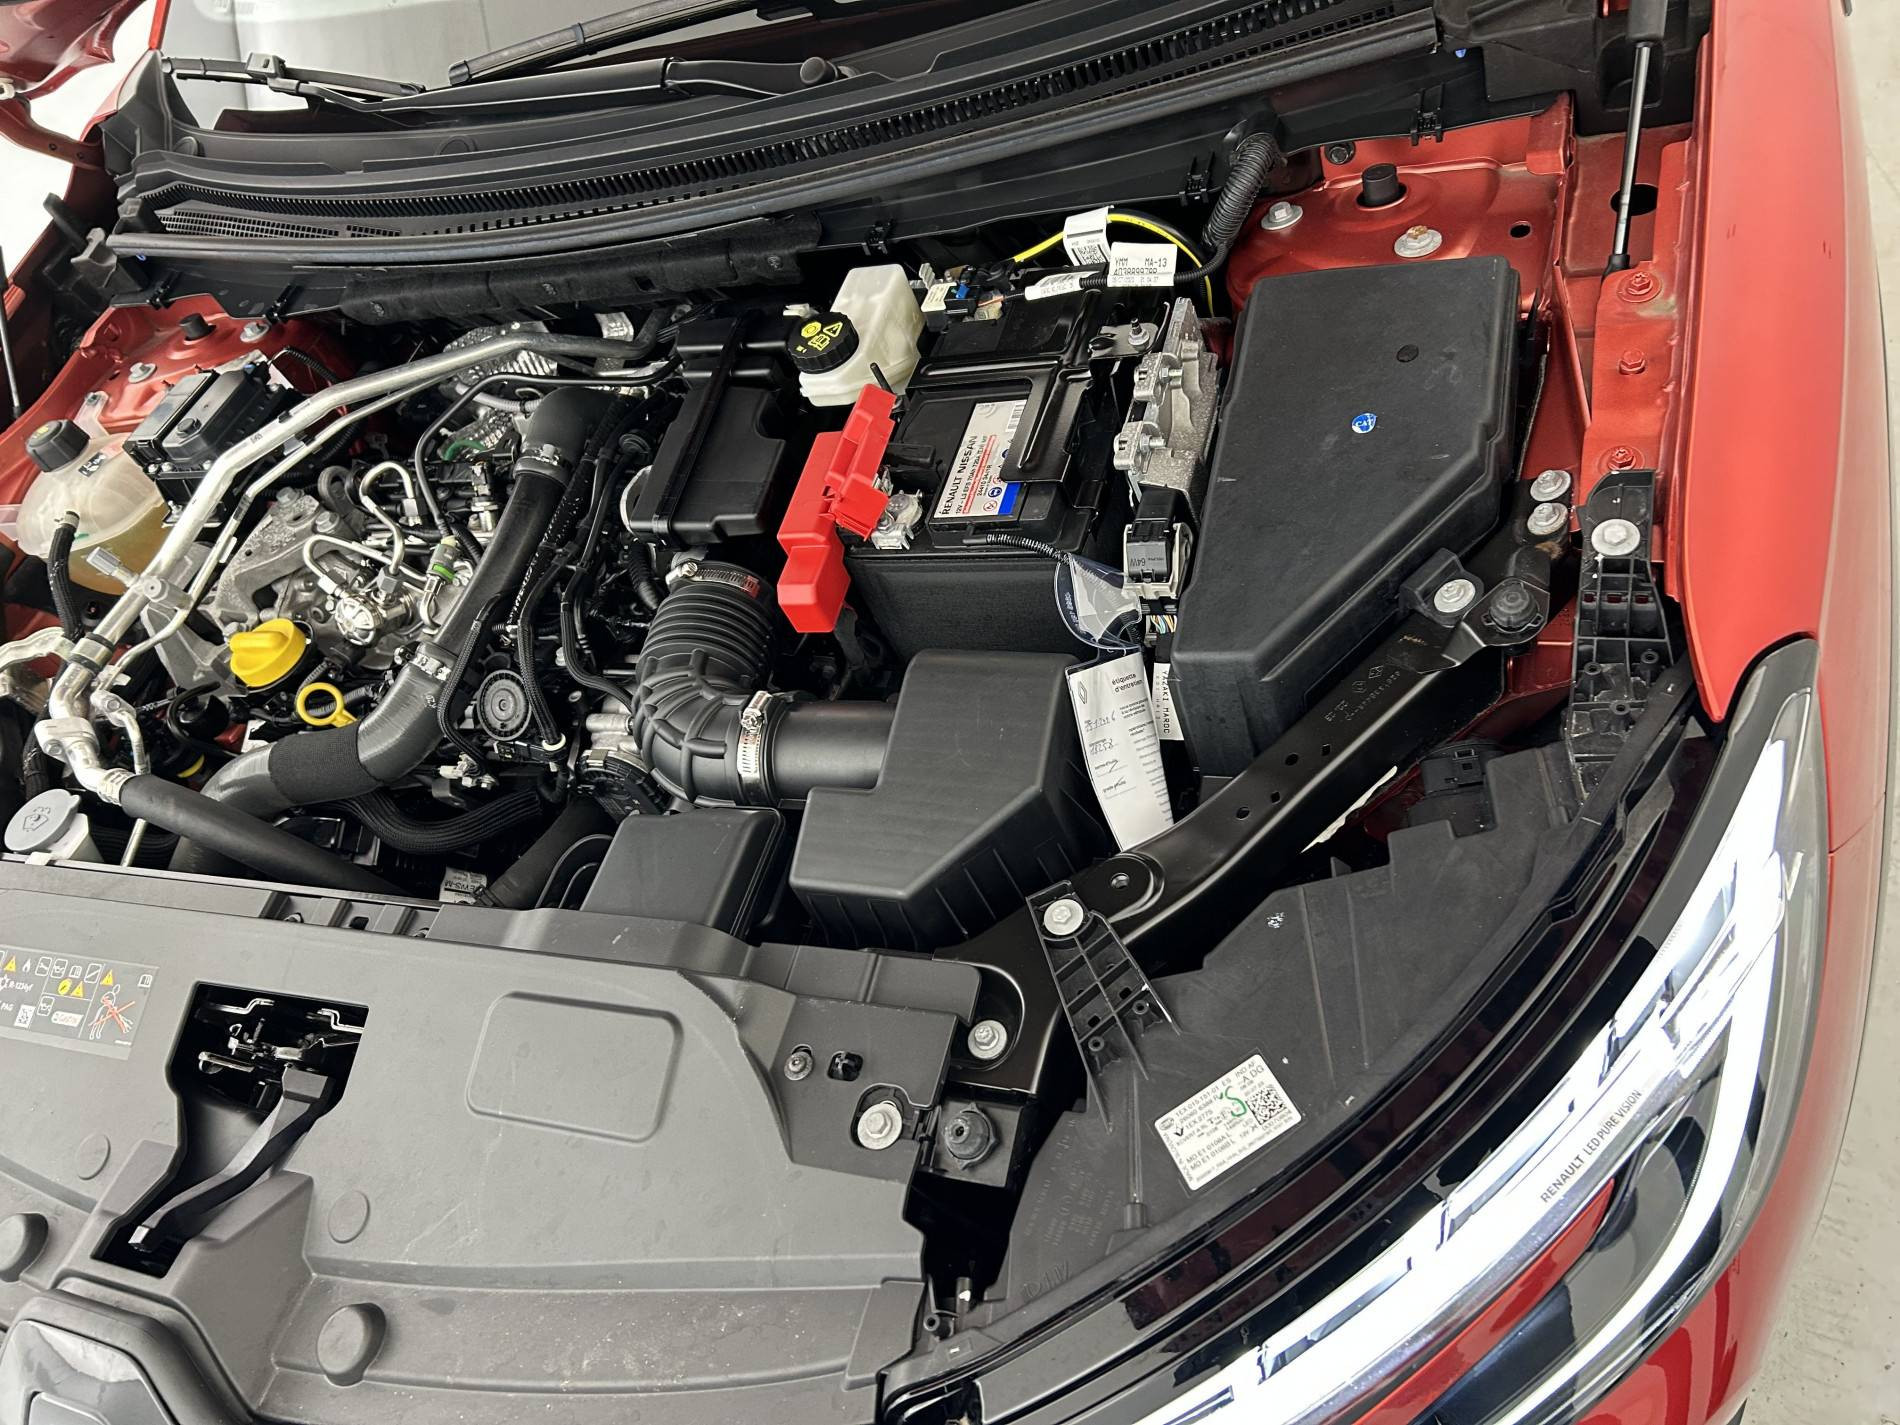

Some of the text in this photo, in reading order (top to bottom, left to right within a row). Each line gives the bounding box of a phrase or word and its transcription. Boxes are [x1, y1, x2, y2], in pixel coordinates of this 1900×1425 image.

[1144, 258, 1168, 268] MA-13
[941, 477, 961, 515] RENAULT
[958, 435, 978, 474] NISSAN
[1112, 673, 1143, 692] étiquette d'entretien
[1540, 1089, 1643, 1203] RENAULT LED PURE VISION
